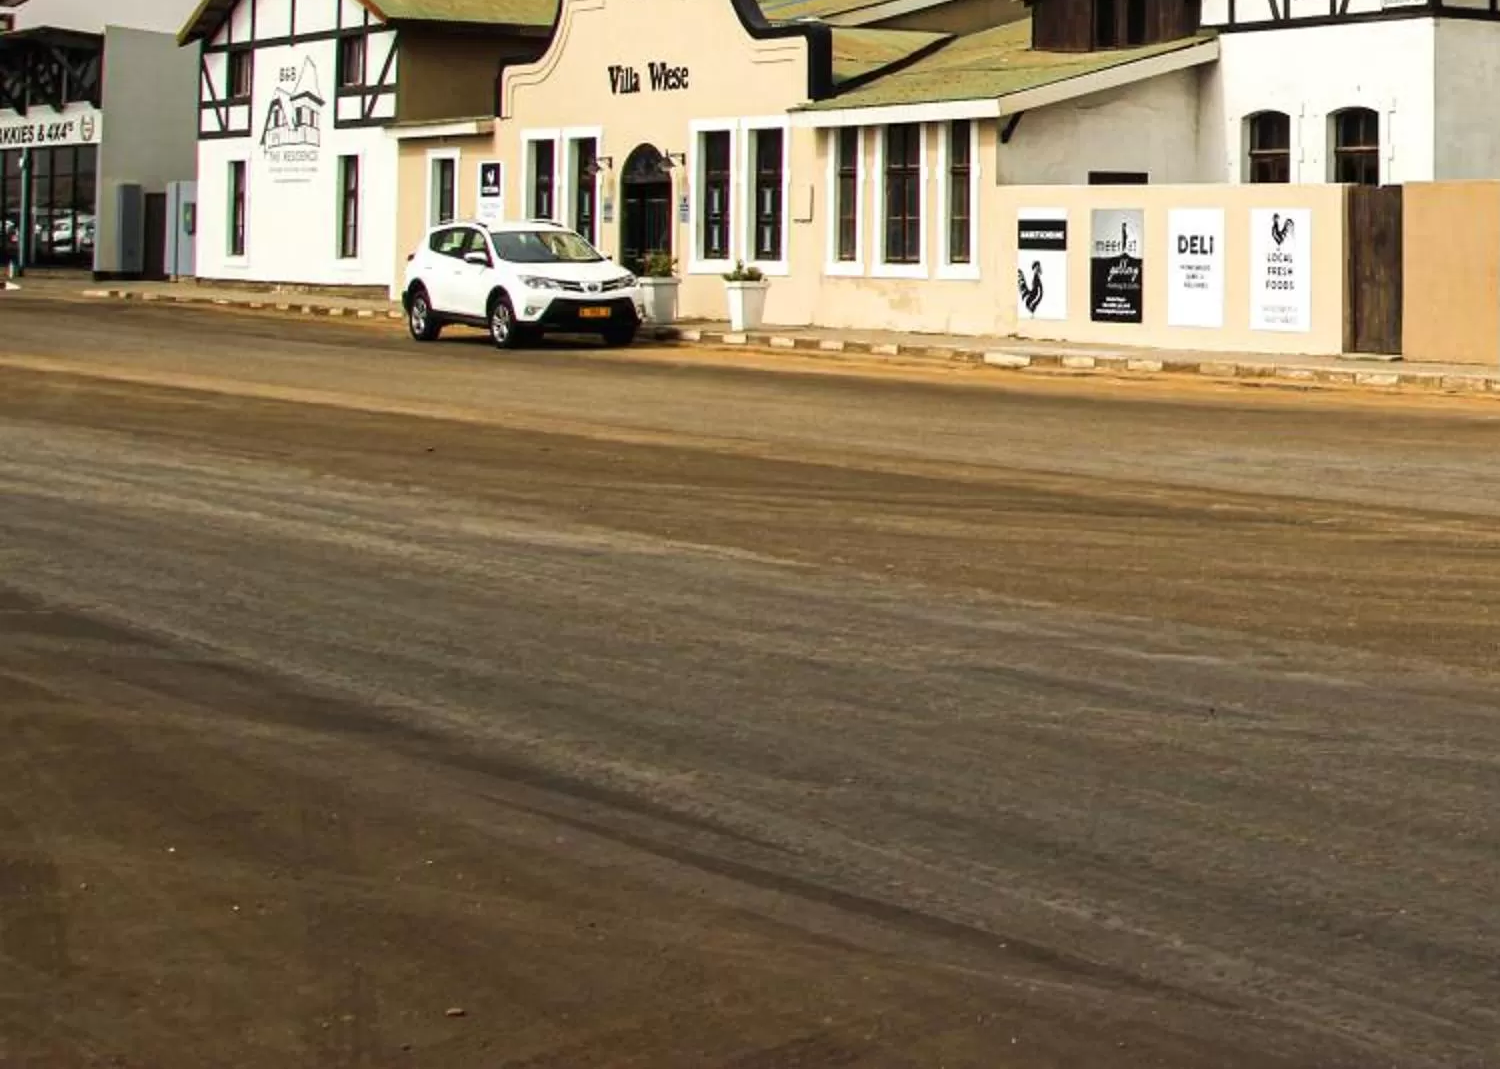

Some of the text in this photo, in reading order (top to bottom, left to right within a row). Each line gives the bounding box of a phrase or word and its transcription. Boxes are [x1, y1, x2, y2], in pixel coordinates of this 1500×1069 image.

[608, 62, 689, 95] Villa Wiese
[0, 125, 34, 143] KKIES
[1177, 234, 1214, 256] DELI
[1267, 252, 1293, 264] LOCAL
[1267, 266, 1293, 277] FRESH
[1265, 279, 1295, 290] FOODS
